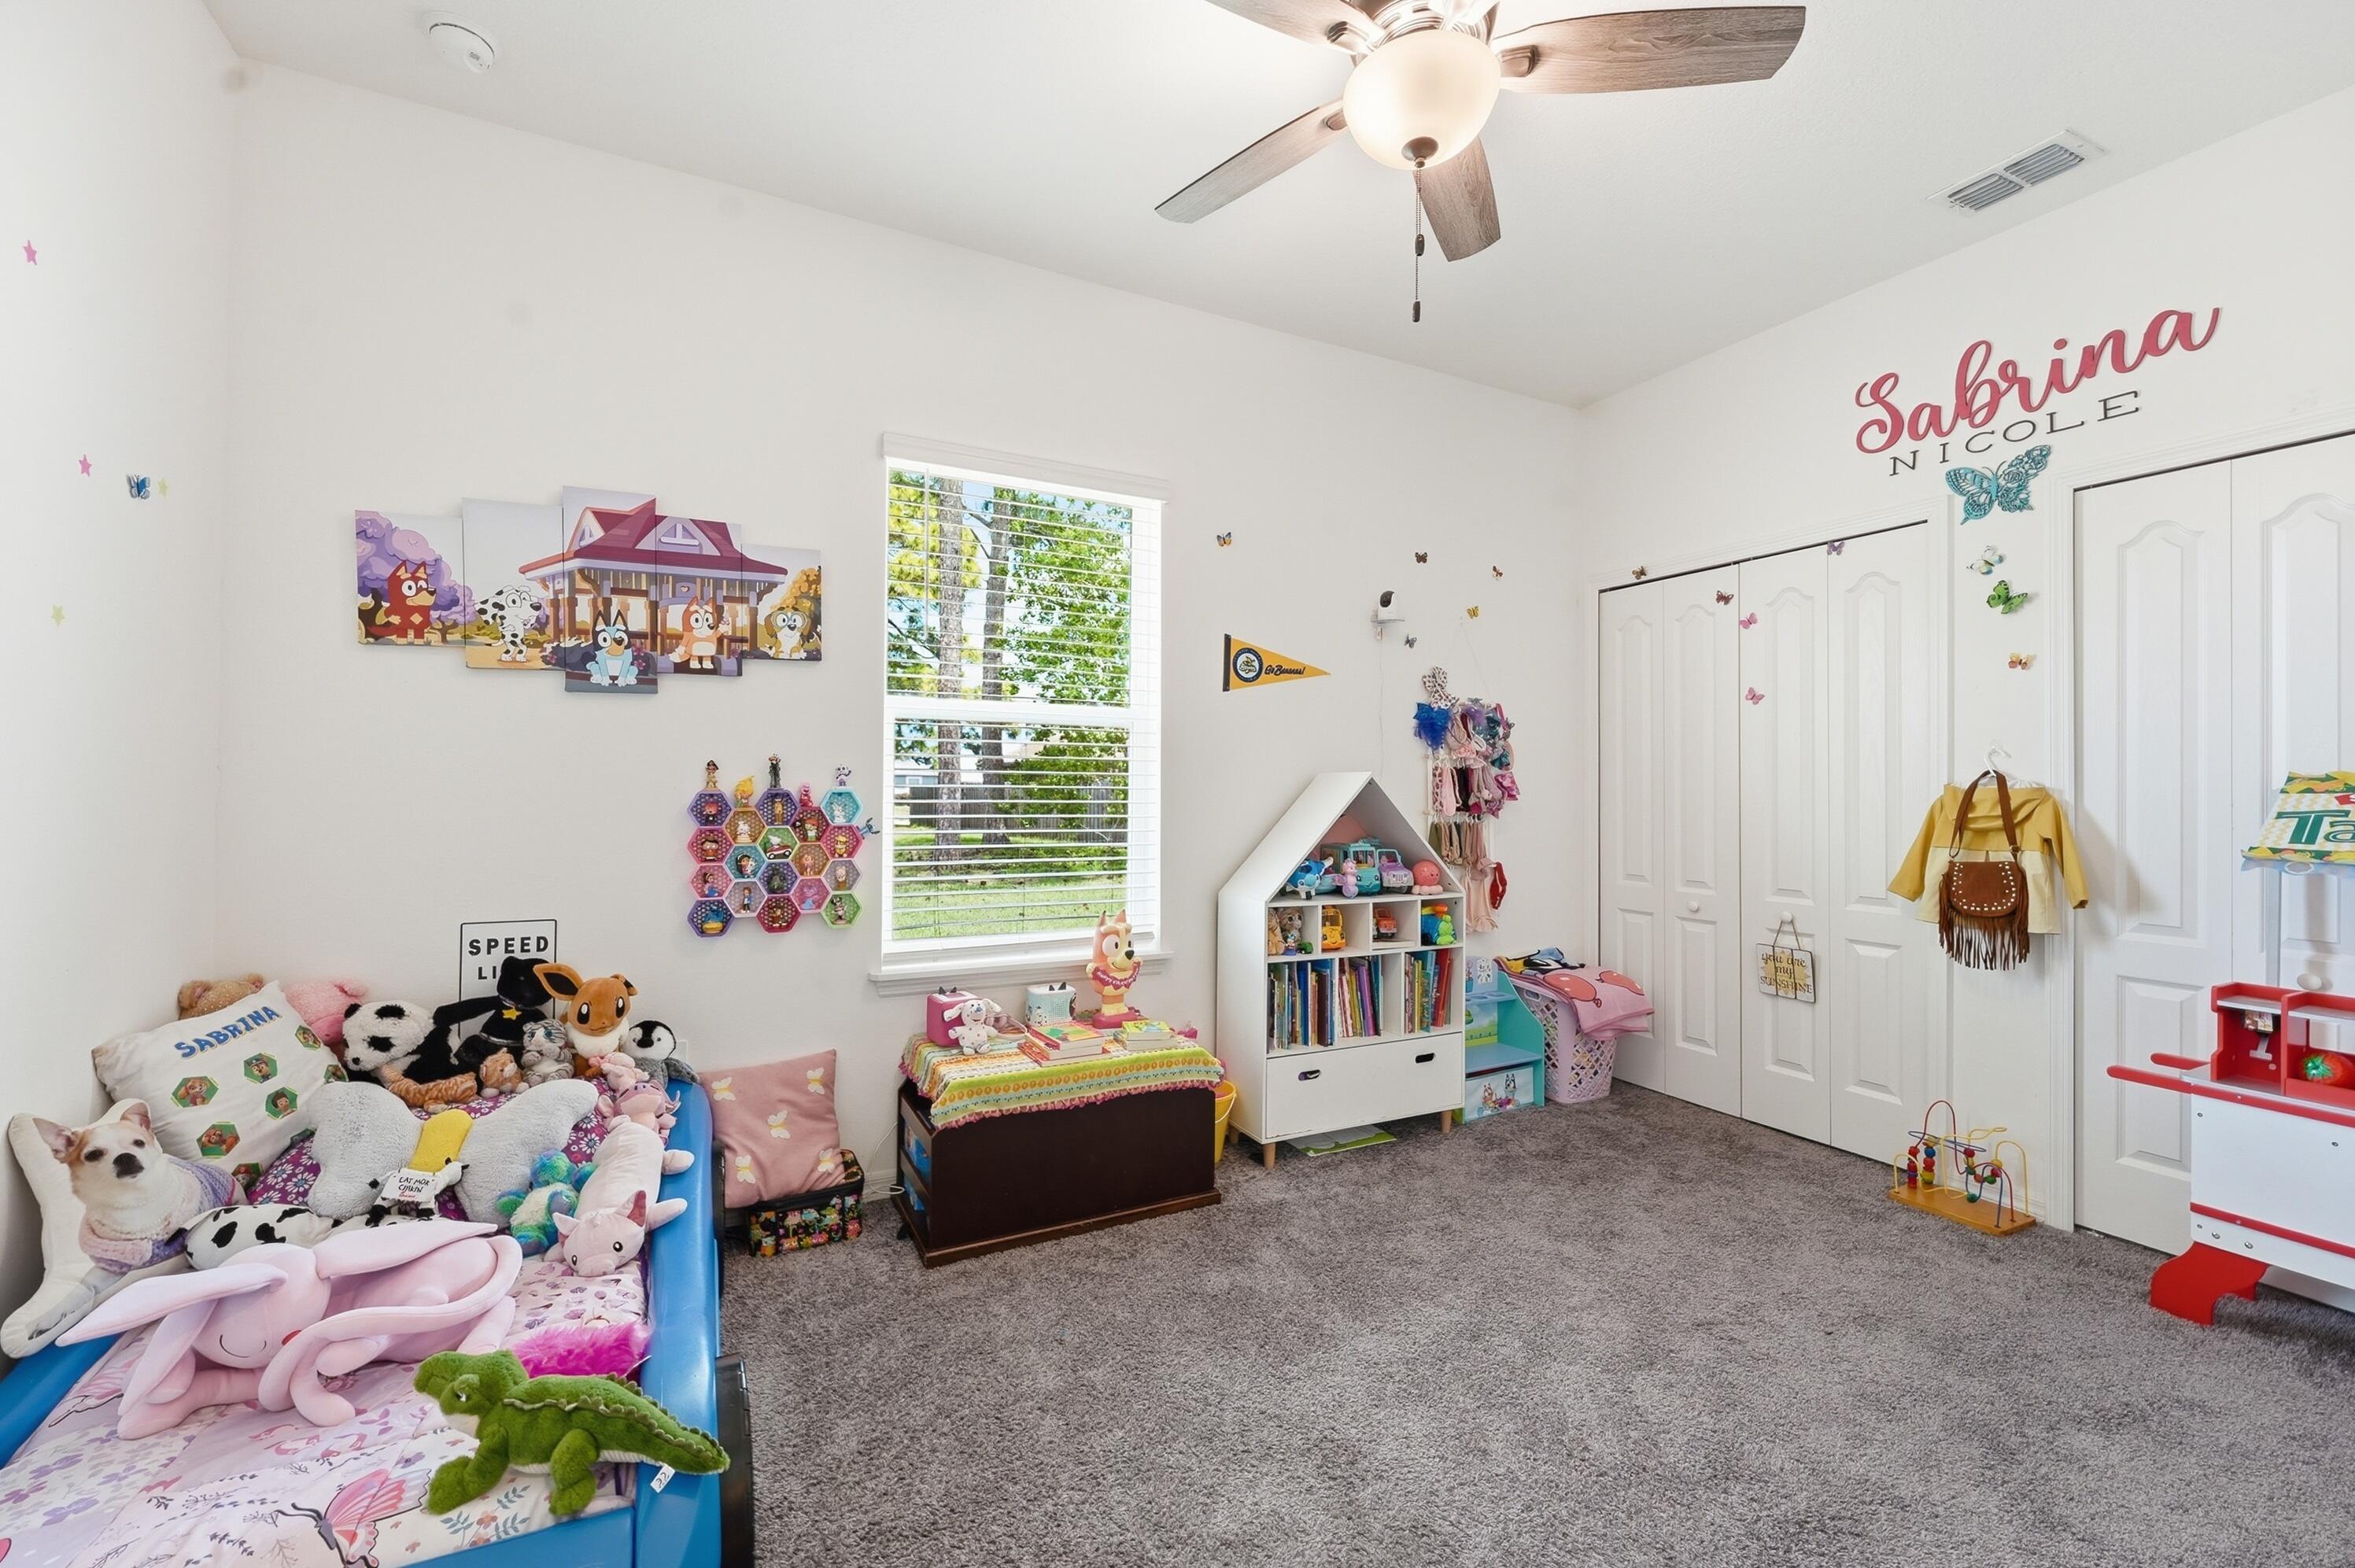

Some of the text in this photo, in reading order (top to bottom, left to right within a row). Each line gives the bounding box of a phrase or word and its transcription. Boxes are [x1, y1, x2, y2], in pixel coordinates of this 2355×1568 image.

[1855, 306, 2221, 454] Sabrina
[1889, 389, 2141, 477] NICOLE
[468, 935, 549, 956] SPEED
[175, 1006, 282, 1058] SABRINA
